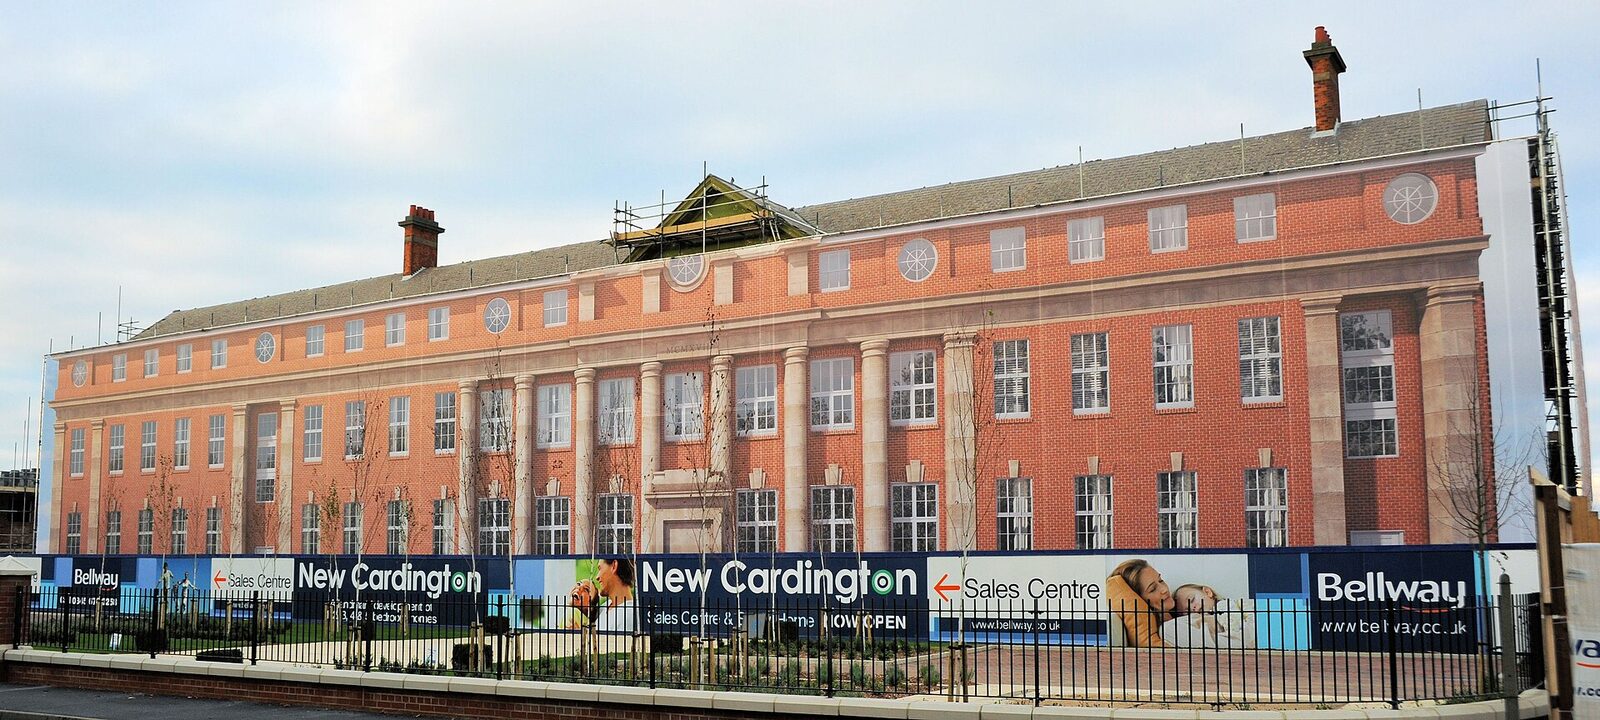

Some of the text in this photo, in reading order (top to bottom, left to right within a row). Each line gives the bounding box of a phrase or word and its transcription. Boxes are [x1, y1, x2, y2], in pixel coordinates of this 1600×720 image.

[74, 568, 119, 590] Bellway
[228, 573, 291, 589] Sales Centre
[298, 562, 482, 599] New Cardington
[642, 560, 917, 603] New Cardington
[964, 578, 1100, 600] Sales Centre
[1317, 571, 1467, 608] Bellway
[681, 611, 720, 625] Cetre
[723, 612, 734, 625] &
[863, 615, 906, 630] OPEN
